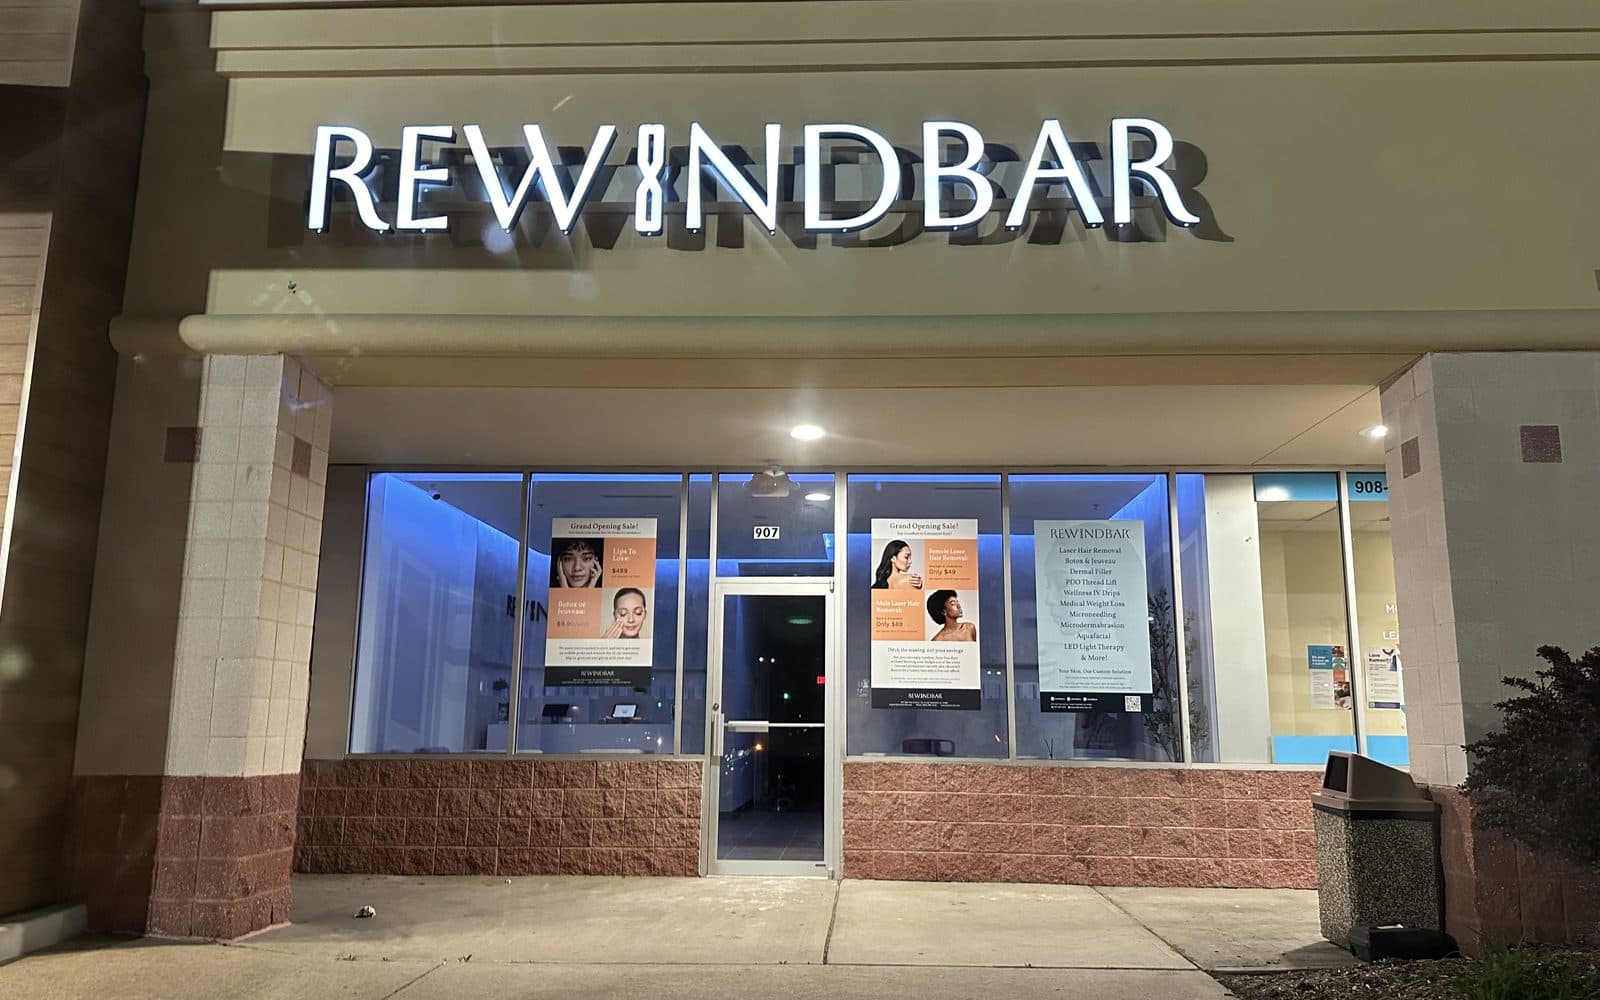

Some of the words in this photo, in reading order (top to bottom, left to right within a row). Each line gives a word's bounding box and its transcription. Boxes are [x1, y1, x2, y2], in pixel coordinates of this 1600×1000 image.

[307, 118, 1200, 235] REWINDBAR
[570, 523, 592, 531] Grand
[592, 523, 621, 531] Opening
[622, 523, 638, 531] Sale!
[890, 522, 910, 530] Grand
[912, 522, 941, 530] Opening
[942, 522, 958, 530] Sale!
[755, 527, 778, 538] 907
[1050, 528, 1130, 539] REWINDBAR
[928, 568, 942, 576] Only
[1060, 600, 1085, 608] Medical
[1086, 600, 1109, 608] Weight
[1110, 600, 1125, 608] Loss
[1064, 643, 1079, 652] LED
[1079, 643, 1096, 652] Light
[1097, 643, 1125, 652] Therapy
